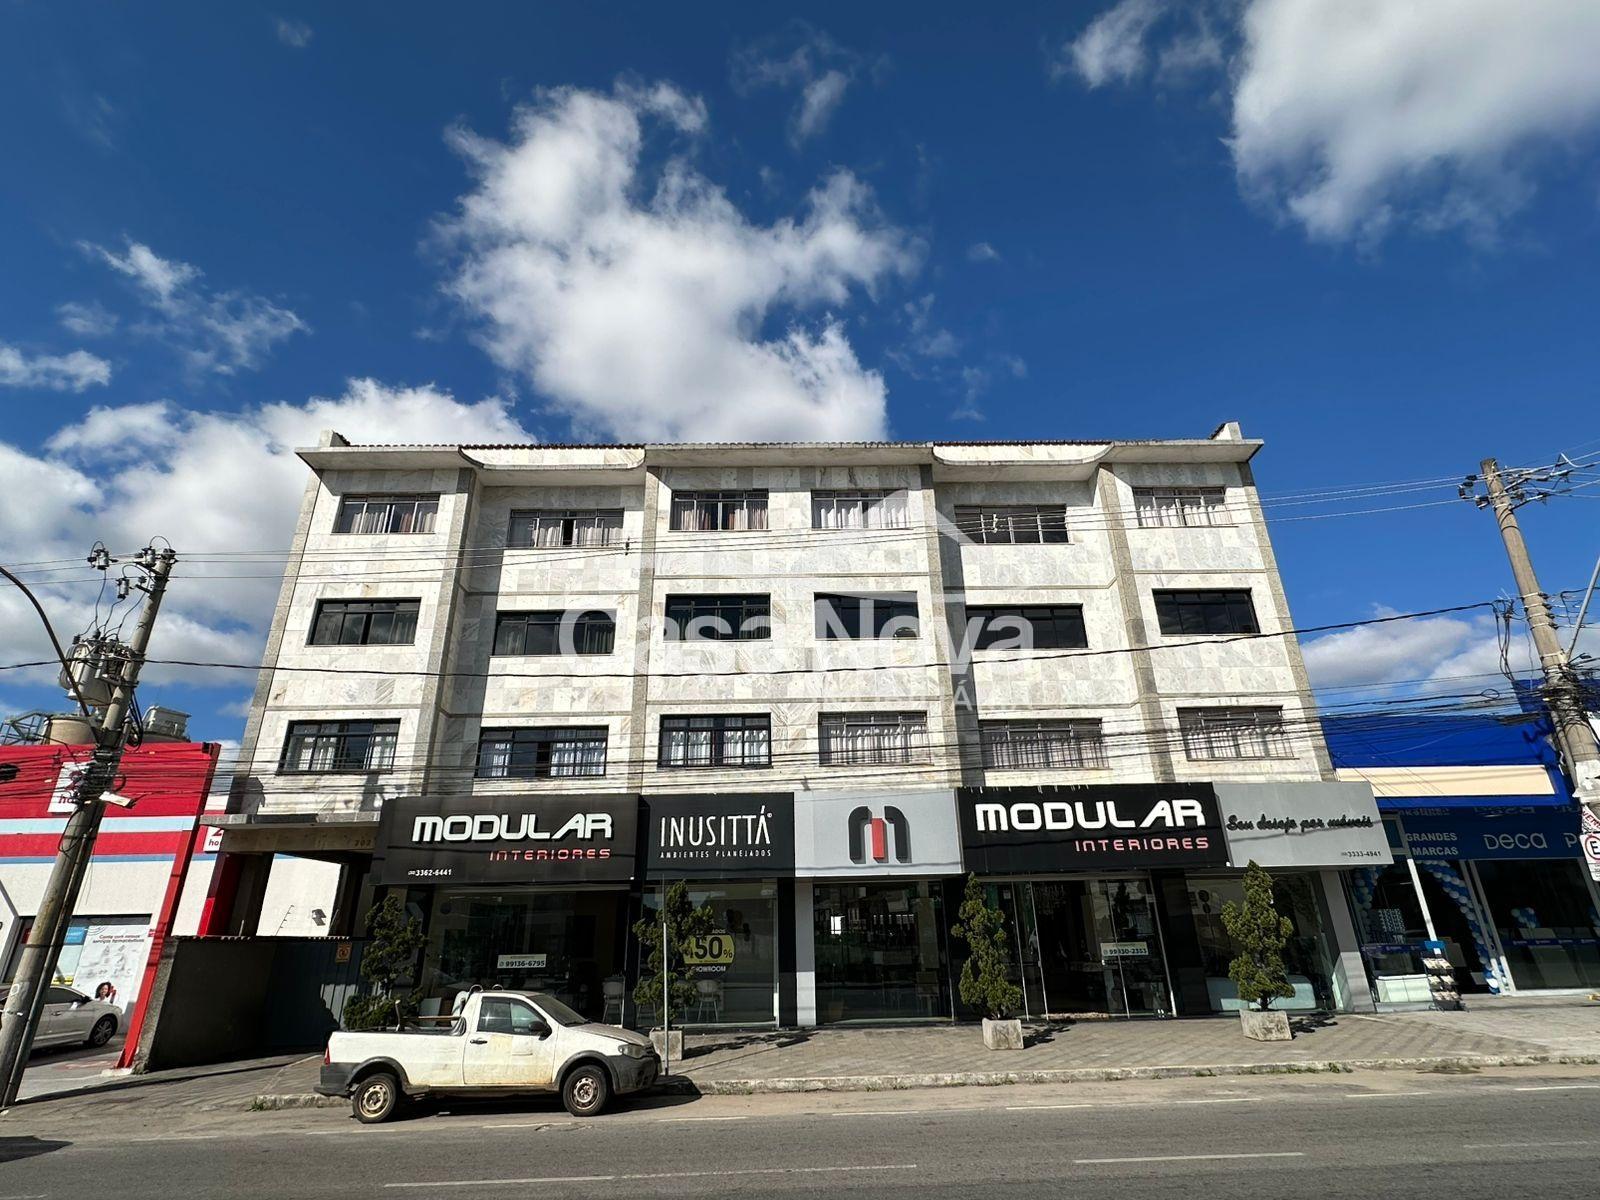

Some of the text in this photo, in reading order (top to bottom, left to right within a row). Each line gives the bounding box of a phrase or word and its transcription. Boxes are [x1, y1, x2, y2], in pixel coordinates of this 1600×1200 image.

[974, 798, 1207, 832] MODULAR
[412, 812, 613, 843] MODULAR
[660, 804, 771, 847] INUSITTÁ
[1075, 836, 1209, 852] INTERIORES
[1405, 832, 1458, 842] GRANDES
[489, 848, 611, 861] INTERIORES
[660, 849, 771, 858] AMBIENTES PLANEJADOS
[1411, 846, 1459, 857] MARCAS
